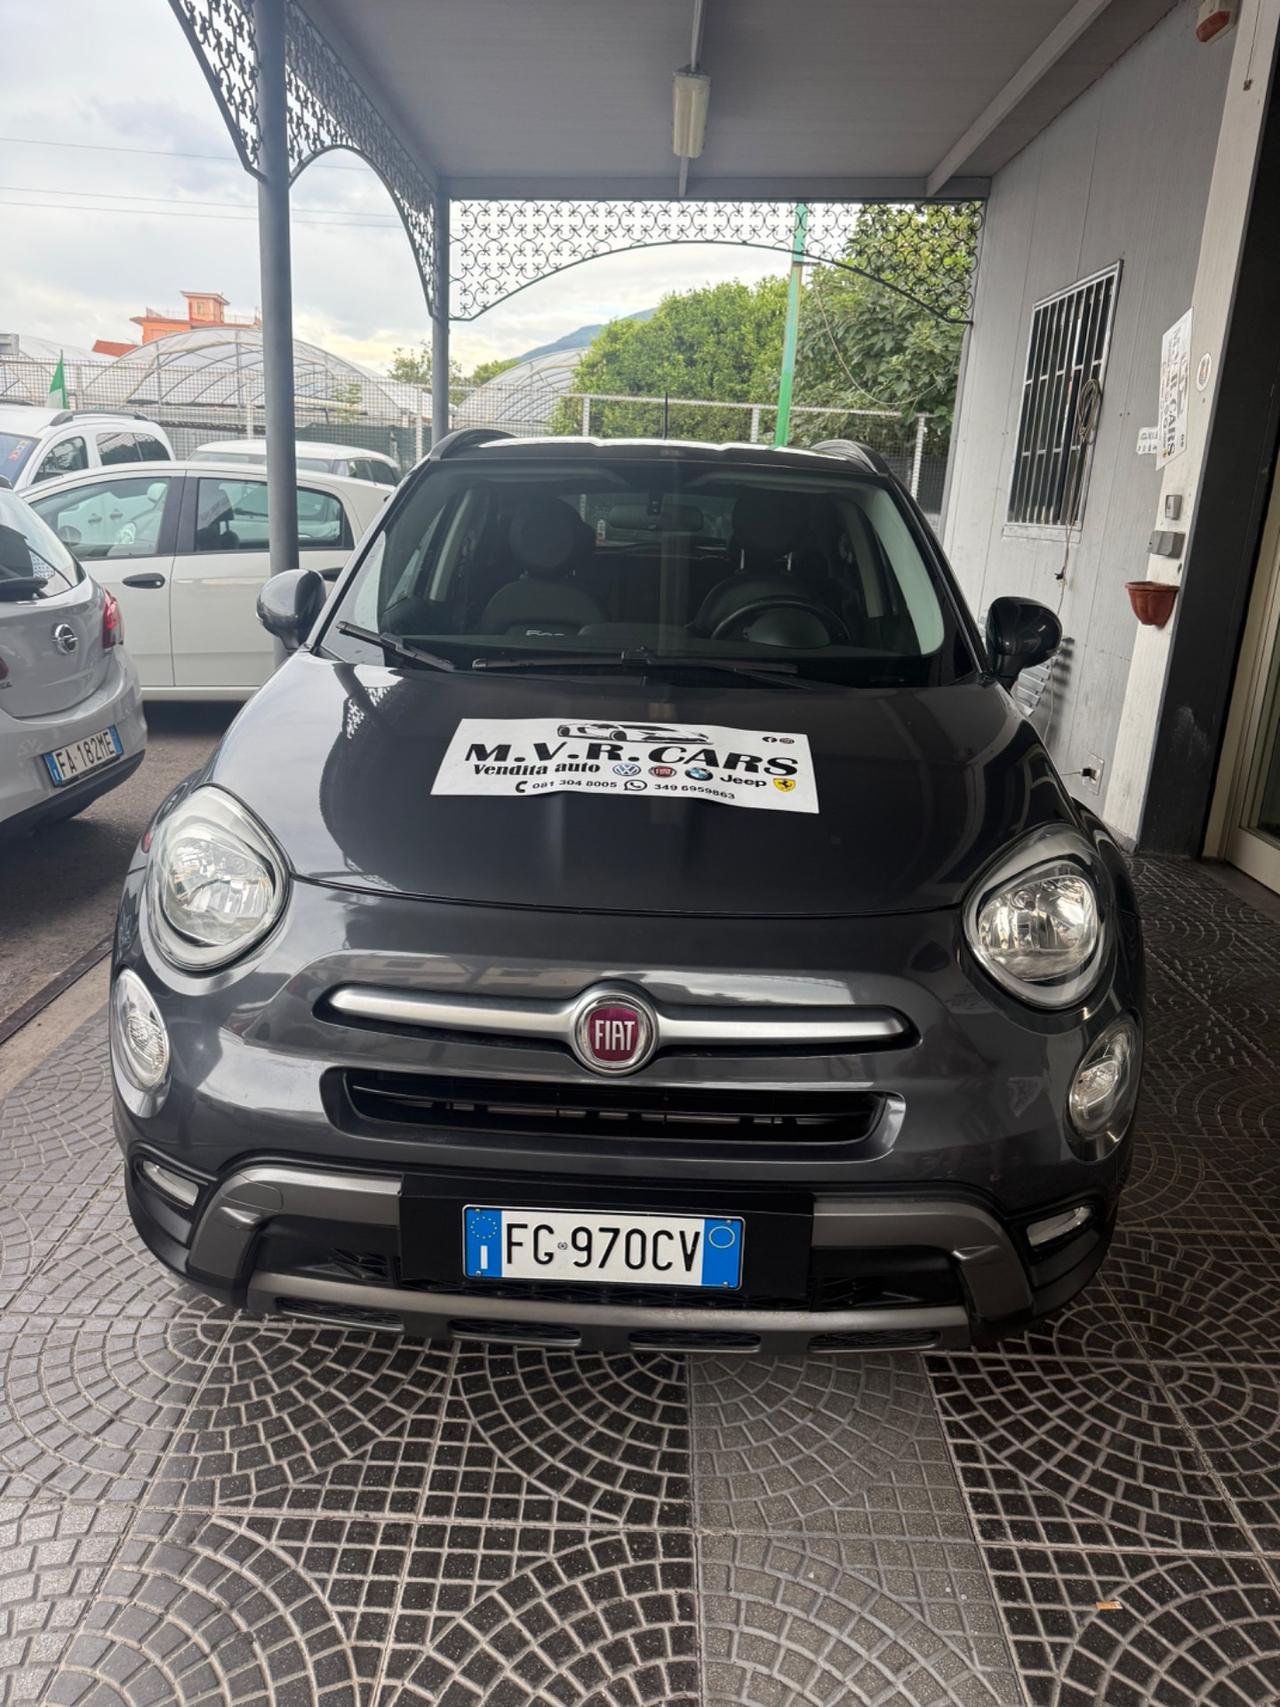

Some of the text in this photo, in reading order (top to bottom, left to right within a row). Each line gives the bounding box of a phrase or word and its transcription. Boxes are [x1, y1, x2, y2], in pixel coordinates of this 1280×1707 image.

[473, 762, 601, 776] Vendita auto
[532, 779, 618, 790] 081 304 8005
[719, 774, 768, 788] Jeep
[654, 783, 736, 800] 349 6959863
[595, 1019, 636, 1051] FIAT
